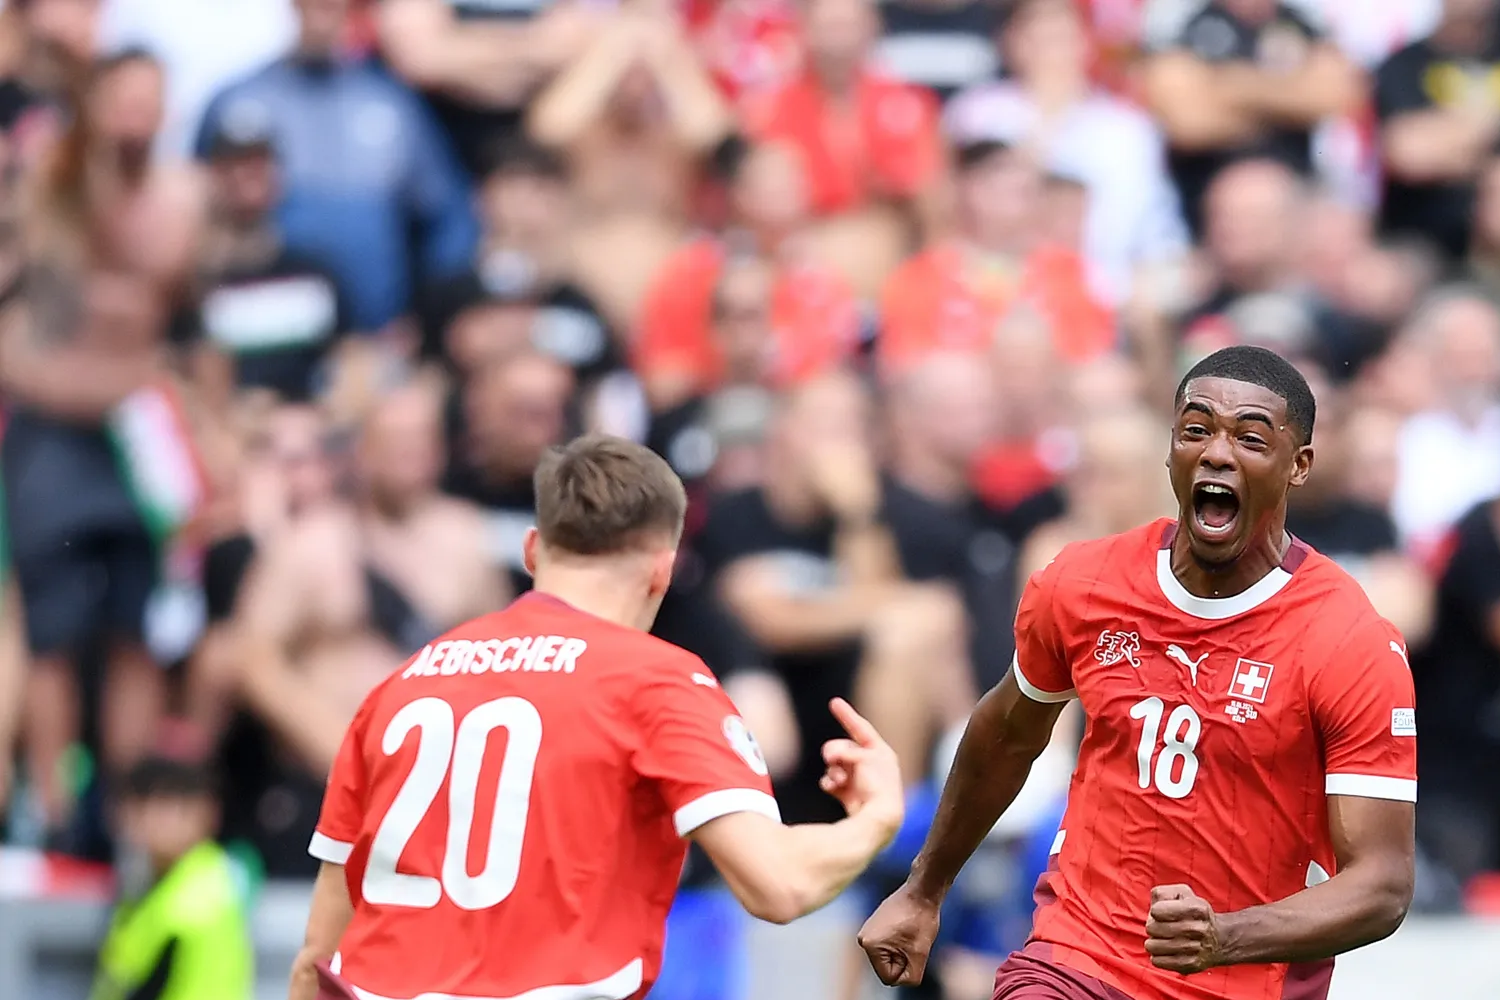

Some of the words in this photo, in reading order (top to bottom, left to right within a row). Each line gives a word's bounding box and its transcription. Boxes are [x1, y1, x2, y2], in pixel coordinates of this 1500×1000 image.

[402, 635, 587, 679] AEBISCHER
[1129, 696, 1202, 799] 18
[362, 696, 543, 910] 20
